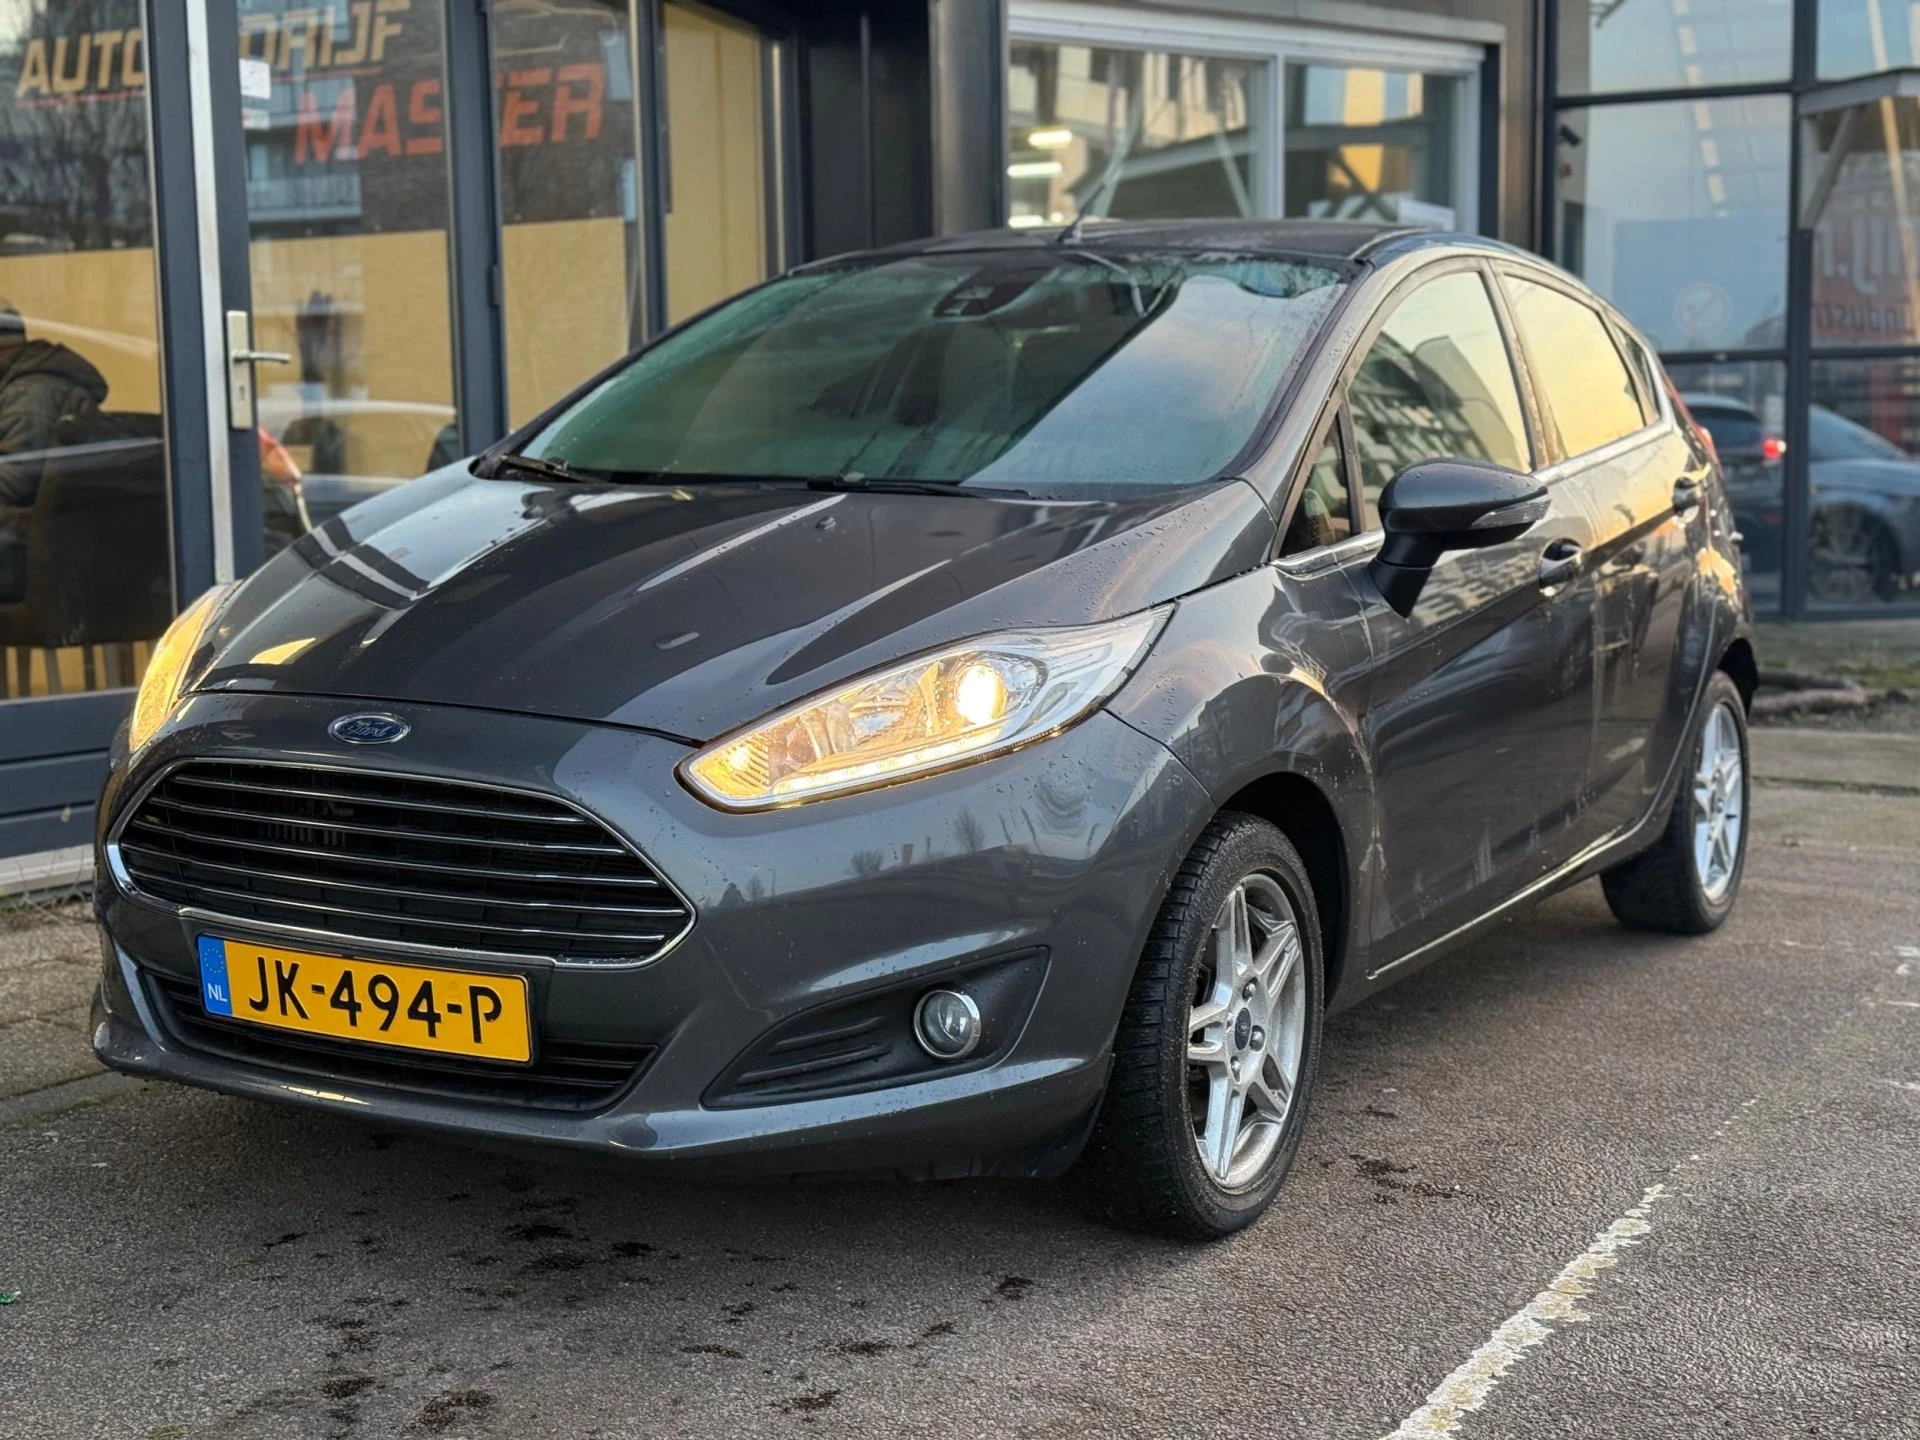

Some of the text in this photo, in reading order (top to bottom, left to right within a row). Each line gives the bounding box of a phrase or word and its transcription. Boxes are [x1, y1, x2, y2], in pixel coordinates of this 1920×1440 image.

[15, 0, 410, 98] AUTODRIJF
[293, 63, 606, 166] MASER
[207, 982, 228, 1003] NL
[248, 955, 503, 1044] JK-494-P
